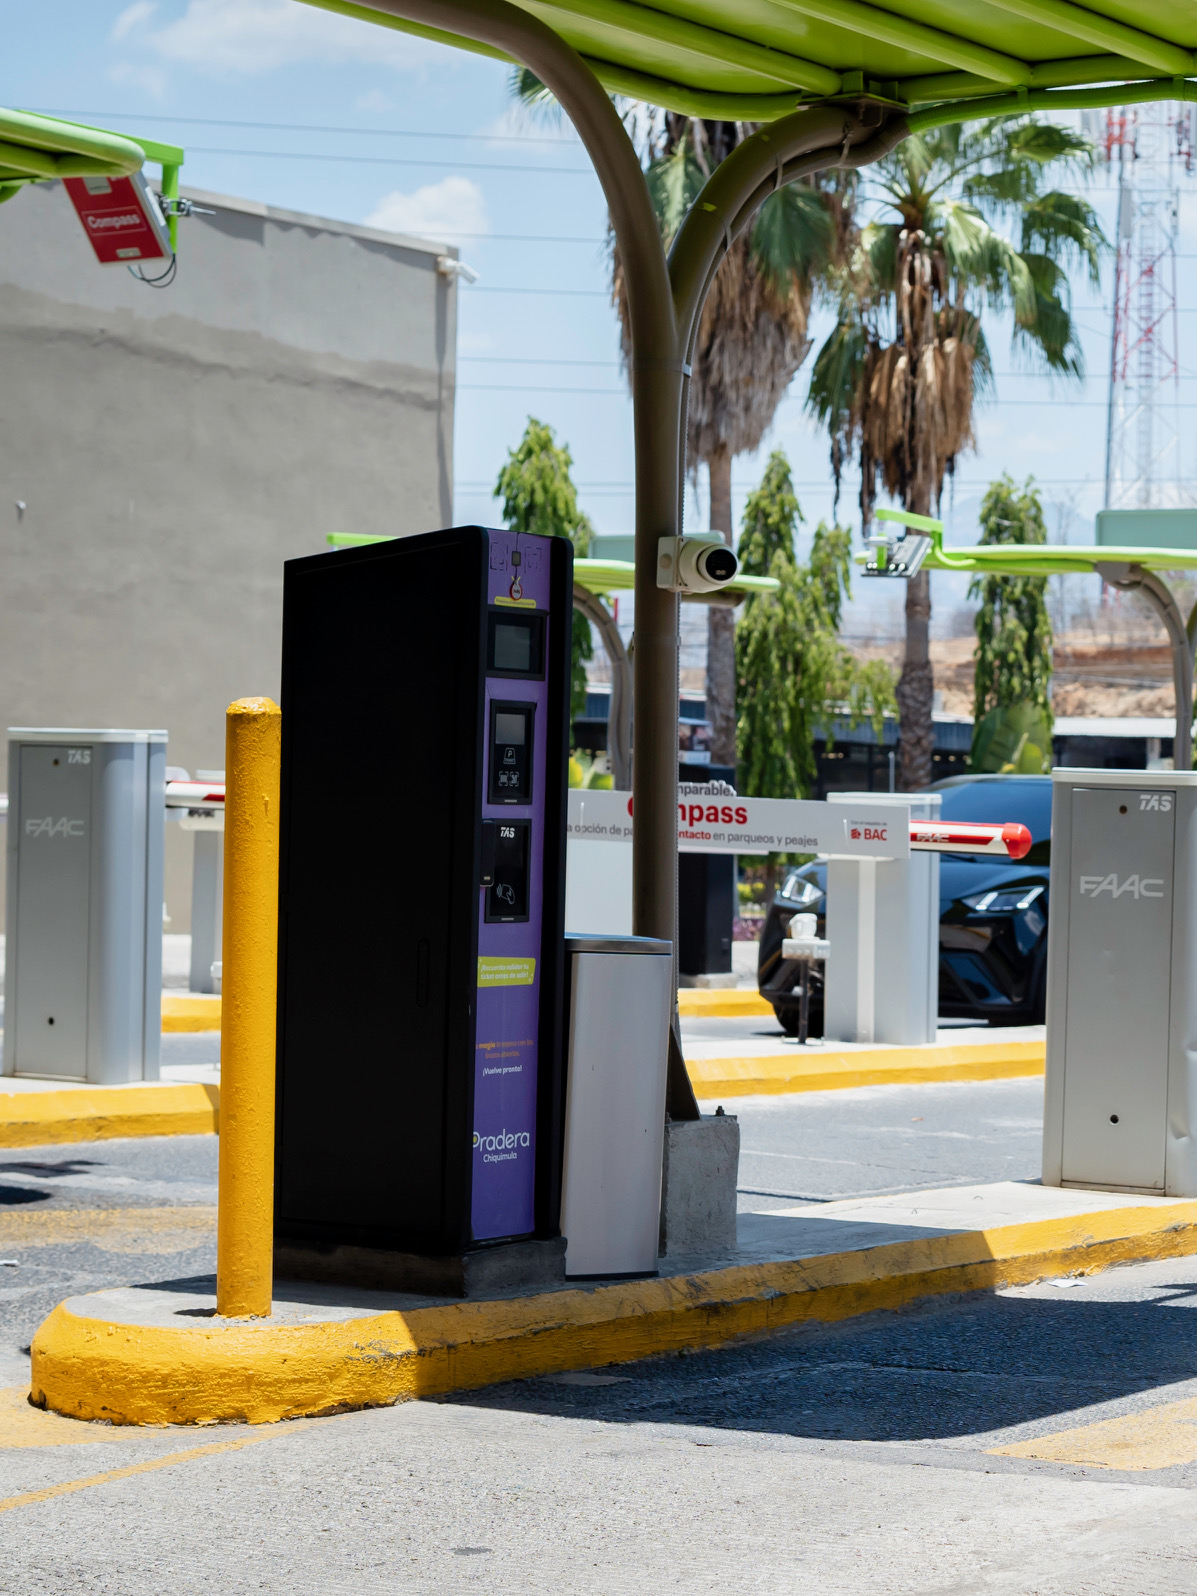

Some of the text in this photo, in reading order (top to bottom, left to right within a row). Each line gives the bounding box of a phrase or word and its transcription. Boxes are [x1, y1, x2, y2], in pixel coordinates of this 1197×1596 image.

[67, 750, 91, 765] TAS
[678, 782, 734, 797] parable.
[1139, 794, 1172, 812] TAS
[25, 817, 84, 838] FAAC
[500, 826, 515, 838] TAS
[609, 824, 621, 835] de
[864, 828, 888, 841] BAC
[678, 830, 818, 847] ntacto en parqueos y peajes
[1080, 873, 1164, 899] FAAC
[483, 1151, 518, 1163] Chiquimula
